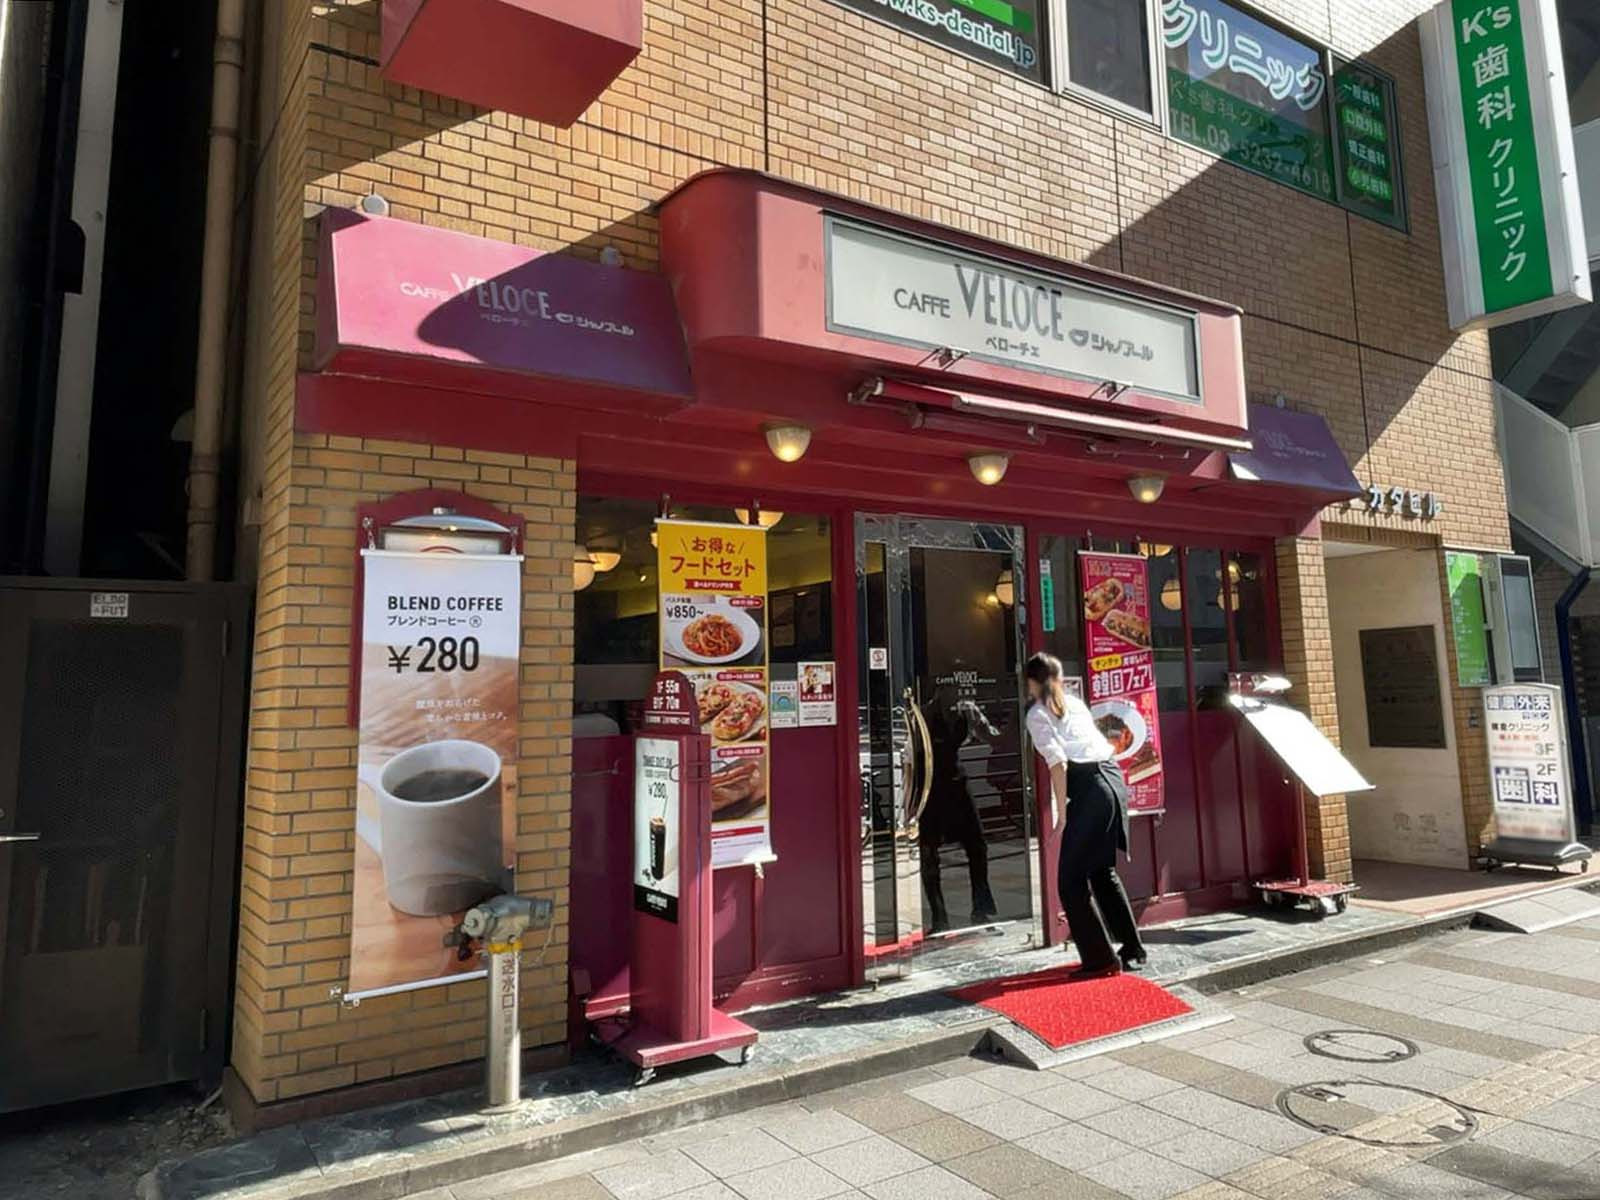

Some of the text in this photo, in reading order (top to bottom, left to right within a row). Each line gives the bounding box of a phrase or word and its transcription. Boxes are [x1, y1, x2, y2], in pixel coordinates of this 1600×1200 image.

[451, 273, 552, 319] VELOCE
[894, 287, 951, 319] CAFFE
[954, 263, 1065, 342] VELOCE
[692, 536, 735, 554] お得な
[670, 556, 756, 578] フードセット
[388, 596, 504, 611] BLEND COFFEE
[387, 615, 467, 626] ブレンドコーヒー
[387, 636, 480, 674] ¥280
[1091, 664, 1154, 699] 韓国フェア!
[1491, 722, 1549, 733] クリニック
[1535, 742, 1556, 756] 3F
[1536, 763, 1557, 776] 2F
[1494, 766, 1559, 805] 歯科
